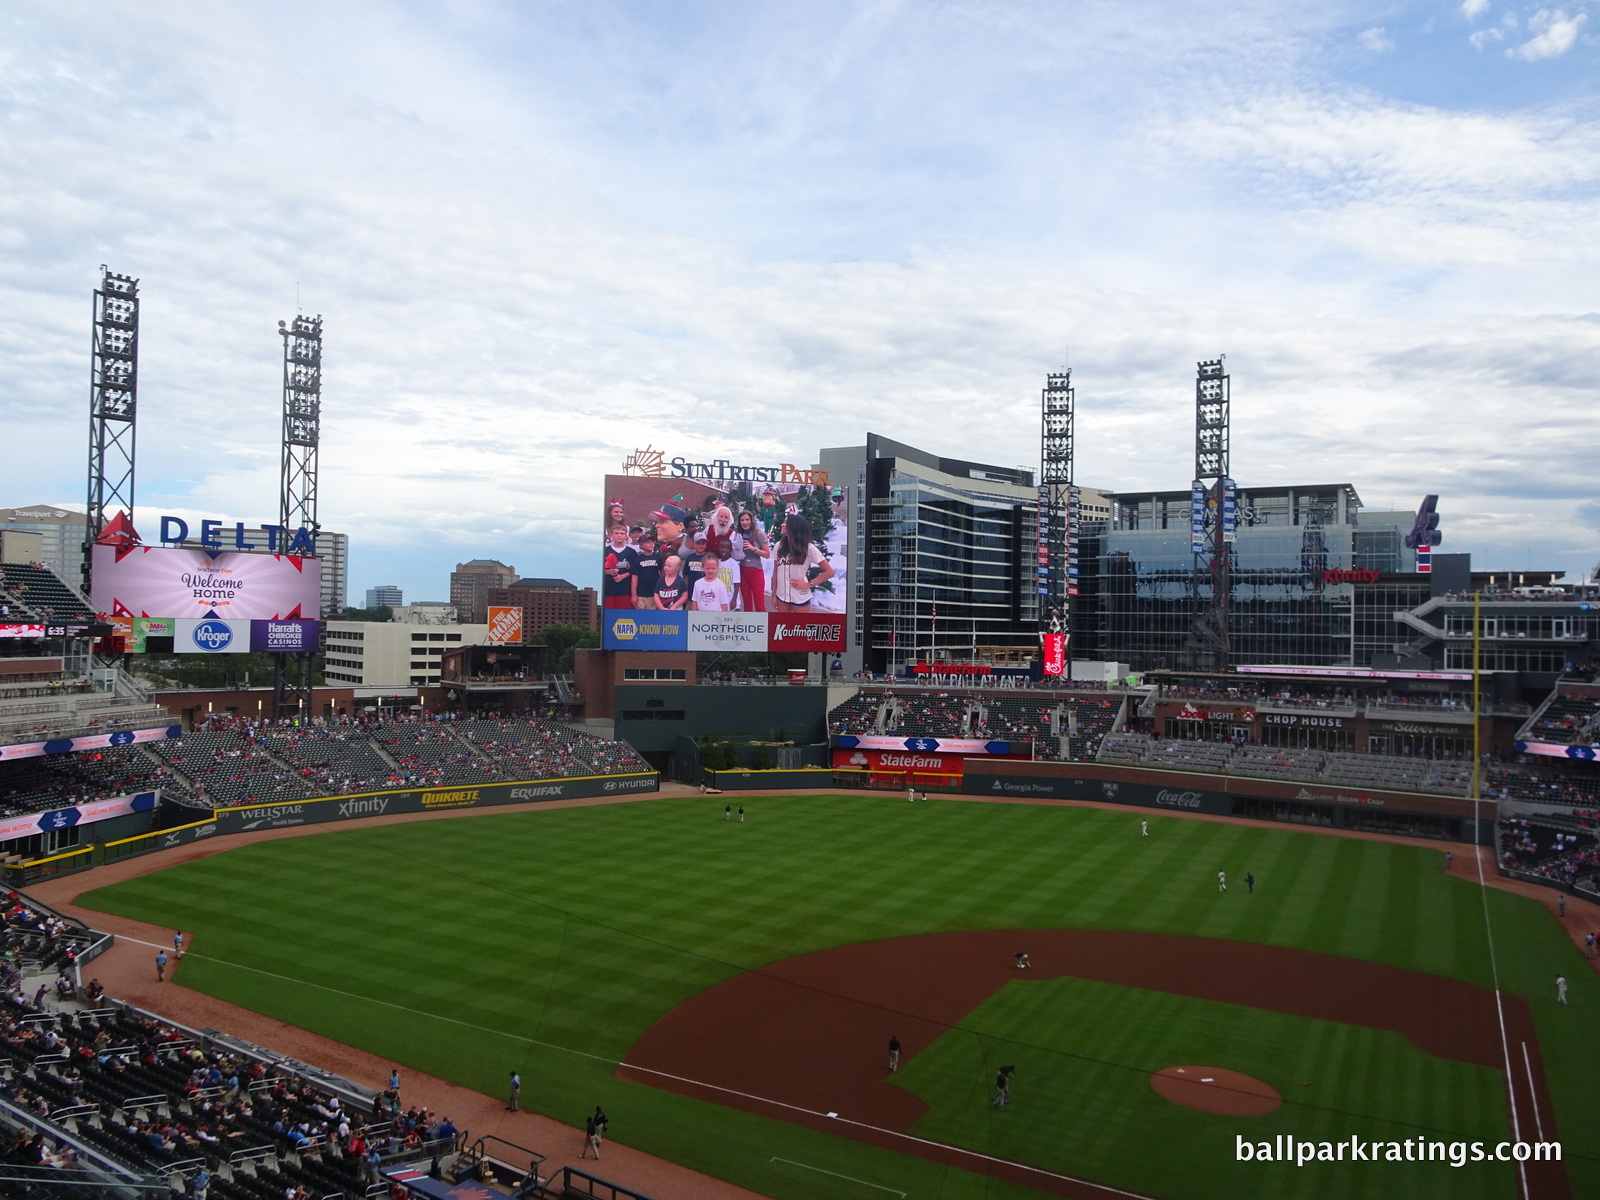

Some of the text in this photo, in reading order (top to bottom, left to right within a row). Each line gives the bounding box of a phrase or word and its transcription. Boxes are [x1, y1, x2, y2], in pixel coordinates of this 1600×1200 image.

[15, 509, 51, 519] Travelport
[1178, 507, 1262, 521] CMAST
[160, 515, 316, 553] DELTA
[181, 573, 244, 589] Welcome
[1323, 566, 1381, 585] xfinity
[488, 607, 522, 641] HOME
[491, 610, 507, 625] THE
[48, 627, 65, 636] 6:35
[268, 623, 302, 633] Harrah's
[501, 620, 522, 641] DEPOT
[617, 624, 679, 635] NAPA KNOW HOW
[692, 624, 765, 634] NORTHSIDE
[773, 624, 841, 641] Kauffman TIRE
[197, 625, 230, 648] Kroger
[1208, 711, 1234, 720] LIGHT
[1266, 714, 1342, 727] CHOP HOUSE
[880, 754, 942, 768] StateFarm
[618, 779, 655, 789] HYUNDAI
[1004, 782, 1054, 793] Georgia Power
[421, 790, 480, 804] QUIKRETE
[510, 785, 563, 800] EQUIFAX
[1156, 788, 1204, 808] Coca-Cola
[241, 804, 302, 819] WELLSTAR
[338, 796, 389, 818] xfinity
